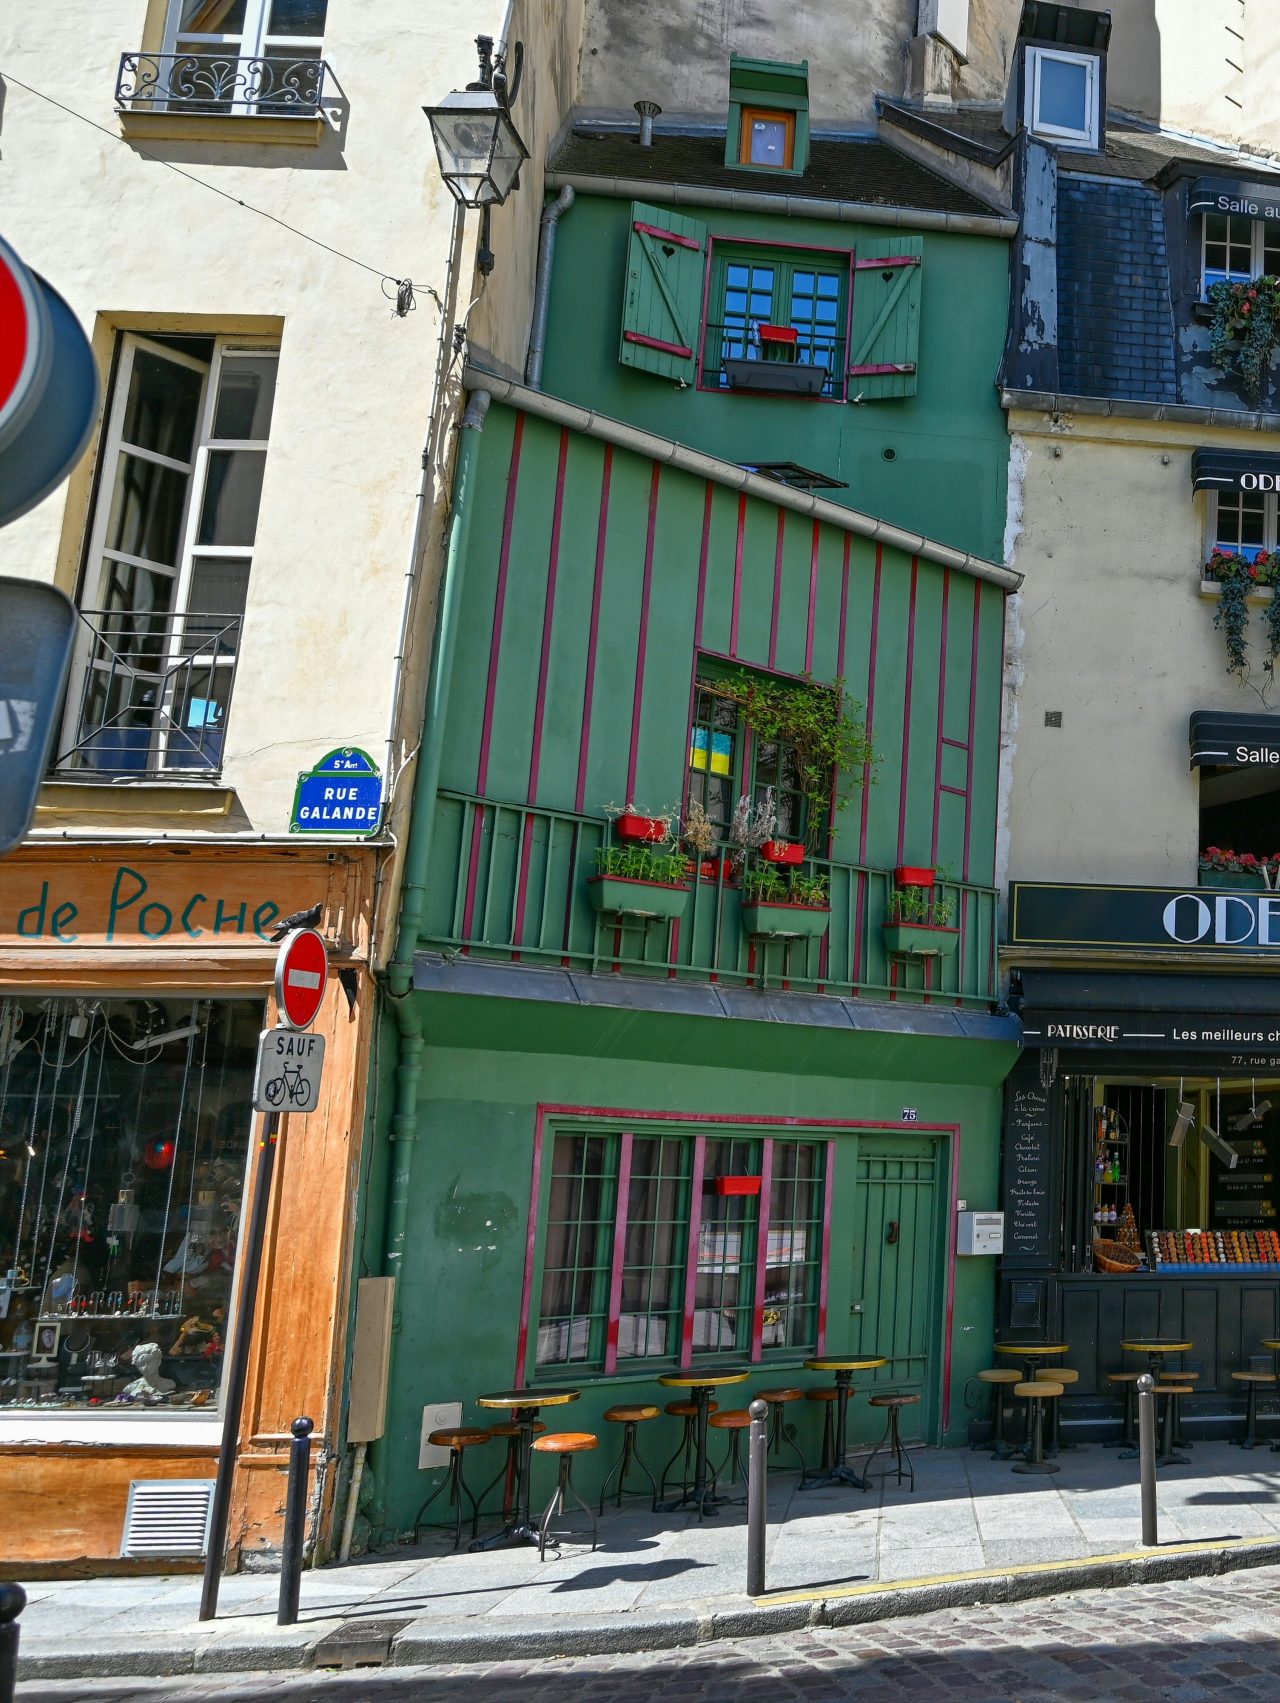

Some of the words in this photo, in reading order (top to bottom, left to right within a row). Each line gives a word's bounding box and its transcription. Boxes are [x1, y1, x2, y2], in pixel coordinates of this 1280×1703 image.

[1217, 196, 1259, 215] Salle
[1236, 746, 1280, 764] Salle
[324, 787, 358, 801] RUE
[300, 806, 378, 820] GALANDE
[17, 881, 78, 943] de
[1047, 1024, 1120, 1042] PATISSERIE
[1173, 1028, 1198, 1041] Les
[1201, 1028, 1264, 1042] meilleurs
[276, 1036, 316, 1057] SAUF
[1231, 1056, 1247, 1066] 77,
[902, 1109, 916, 1120] 75
[1014, 1143, 1041, 1151] Chocolat
